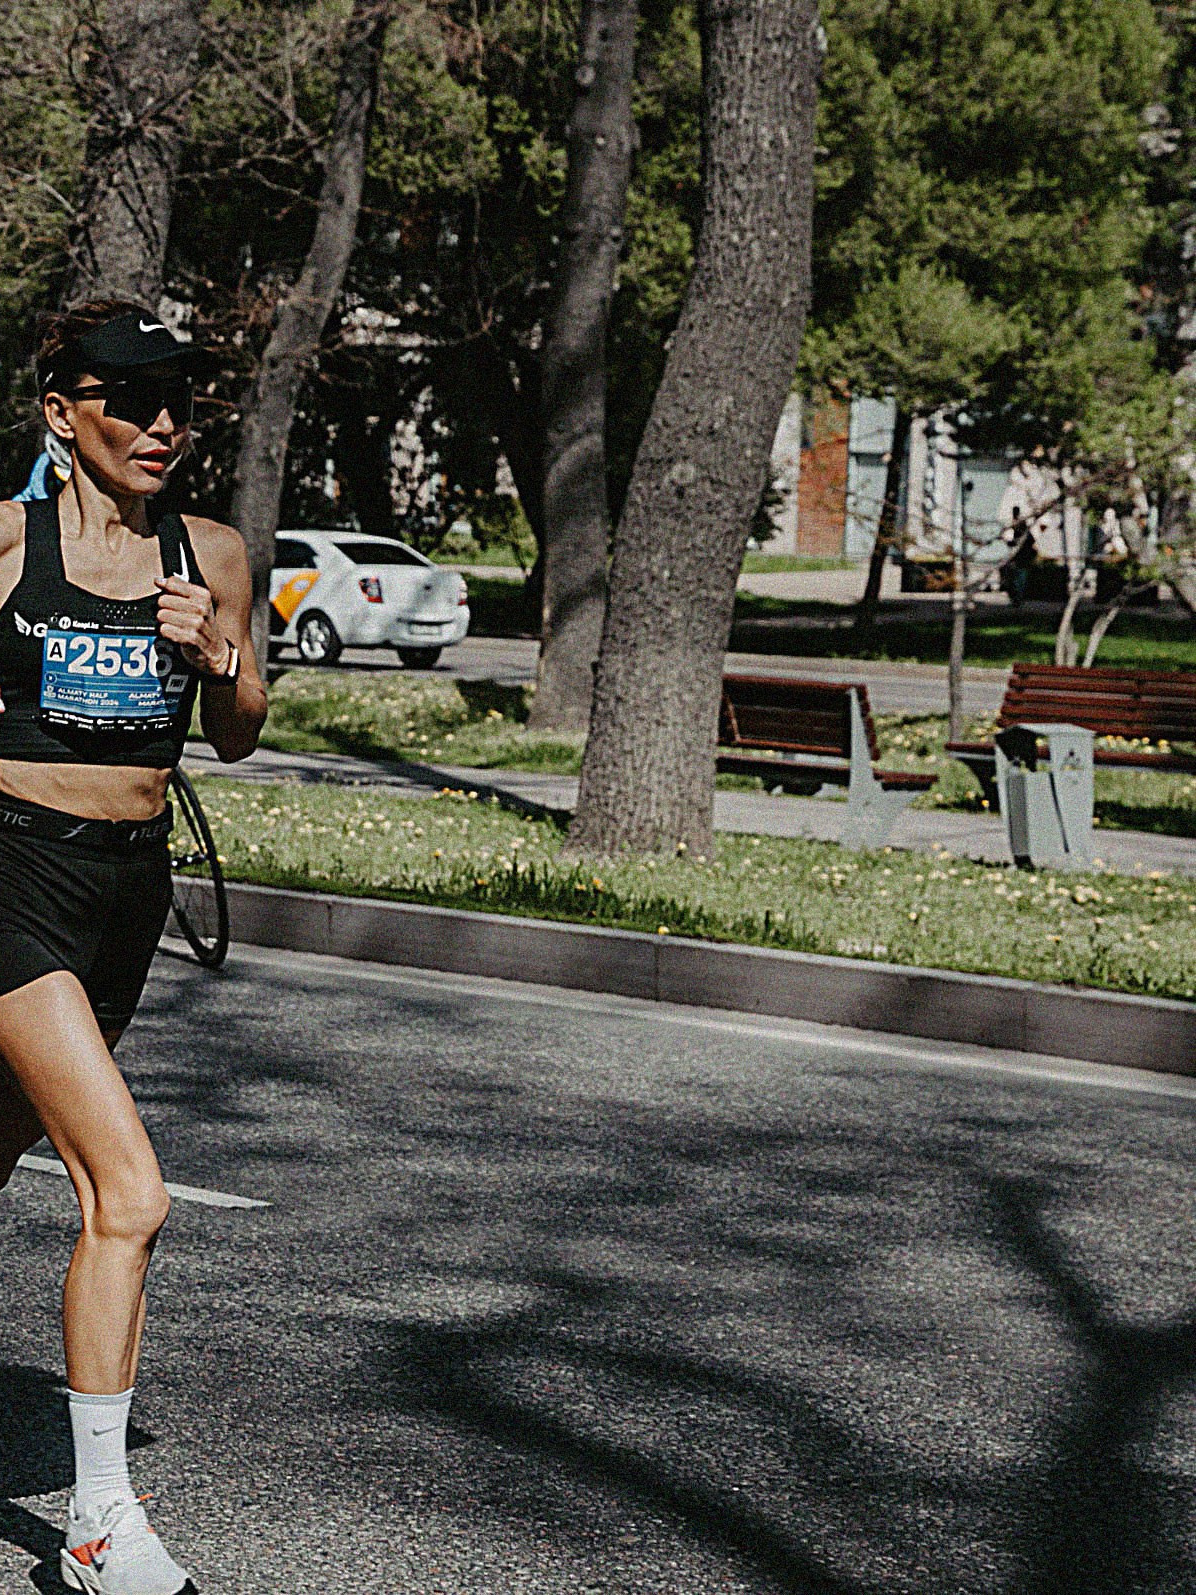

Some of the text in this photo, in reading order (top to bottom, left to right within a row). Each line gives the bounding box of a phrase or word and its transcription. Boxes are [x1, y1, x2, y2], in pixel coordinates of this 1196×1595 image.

[49, 635, 174, 678] A 2536
[57, 687, 88, 698] ALMATY
[57, 693, 99, 705] MARATHON
